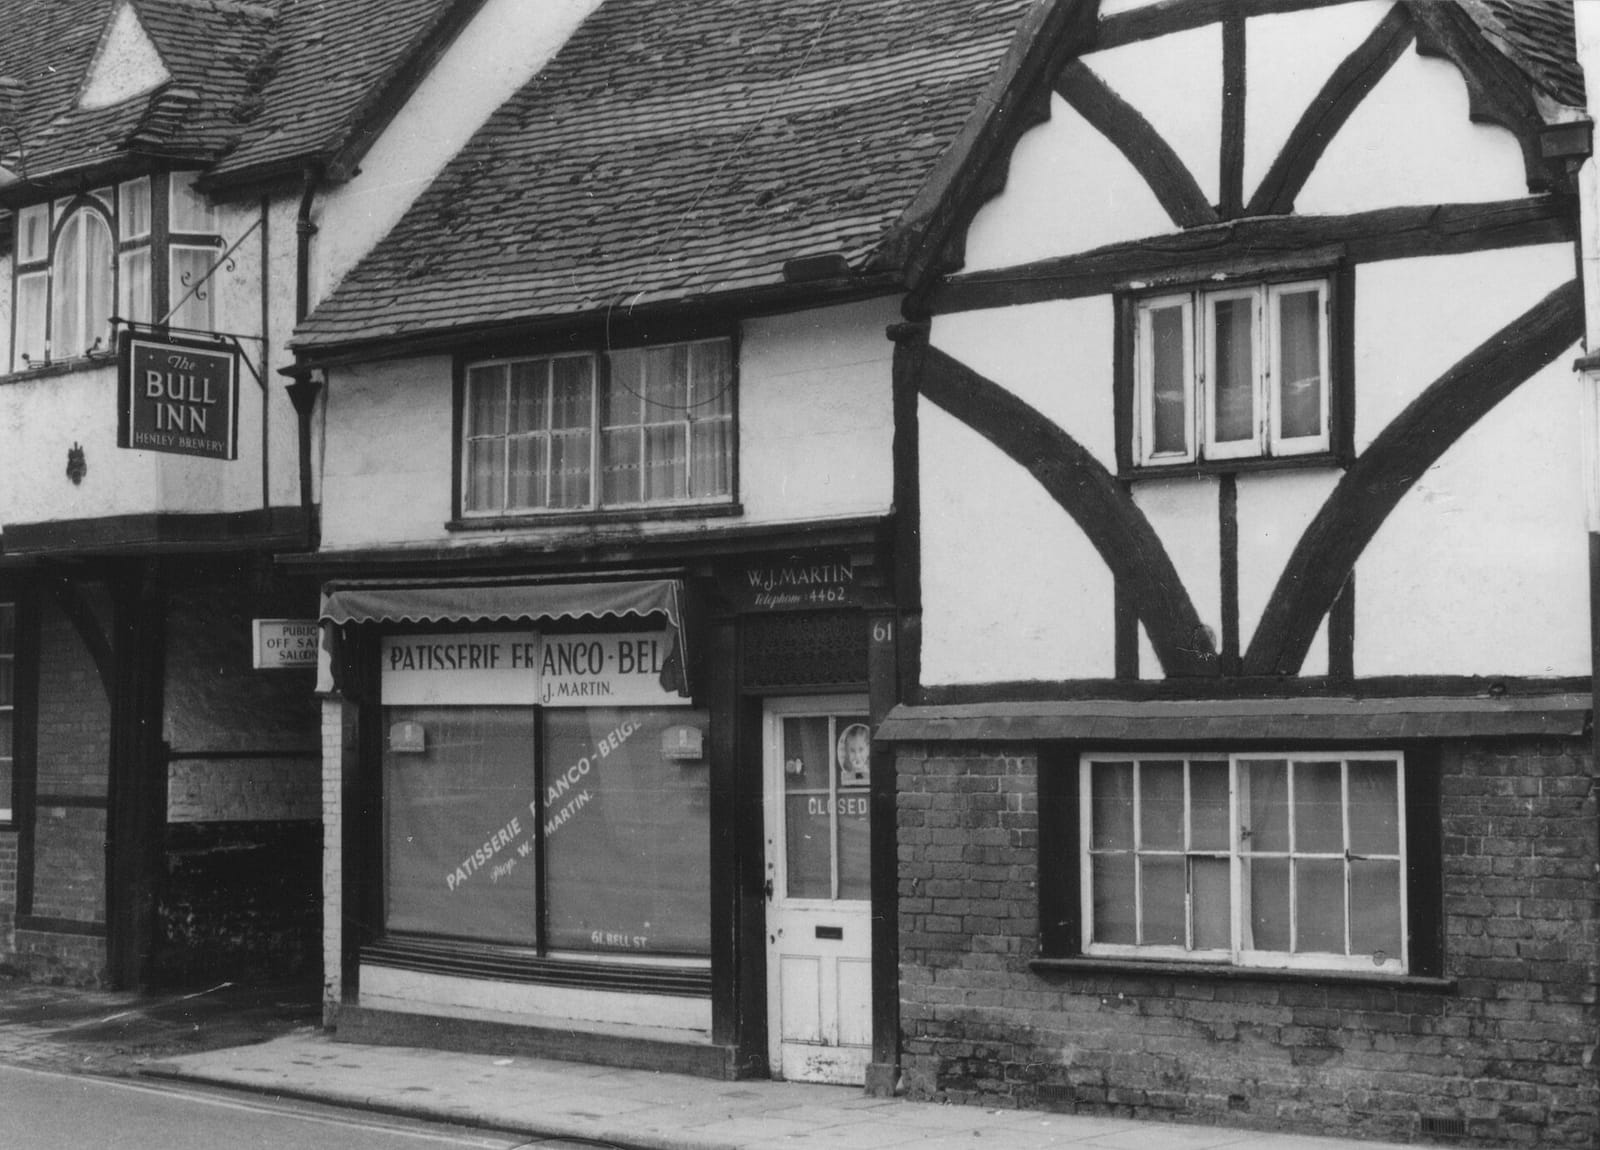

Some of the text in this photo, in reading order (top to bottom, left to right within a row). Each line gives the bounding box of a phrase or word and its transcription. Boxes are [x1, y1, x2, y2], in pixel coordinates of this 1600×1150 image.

[167, 355, 196, 371] The
[146, 369, 217, 404] BULL
[156, 402, 206, 433] INN
[135, 432, 224, 452] HENLEY BREWERY
[282, 626, 317, 636] PUBLIC
[872, 621, 892, 642] 61
[266, 638, 319, 649] OFF SAL
[390, 643, 500, 671] PATISSERIE
[446, 816, 522, 892] PATISSERIE
[632, 935, 648, 949] ST
